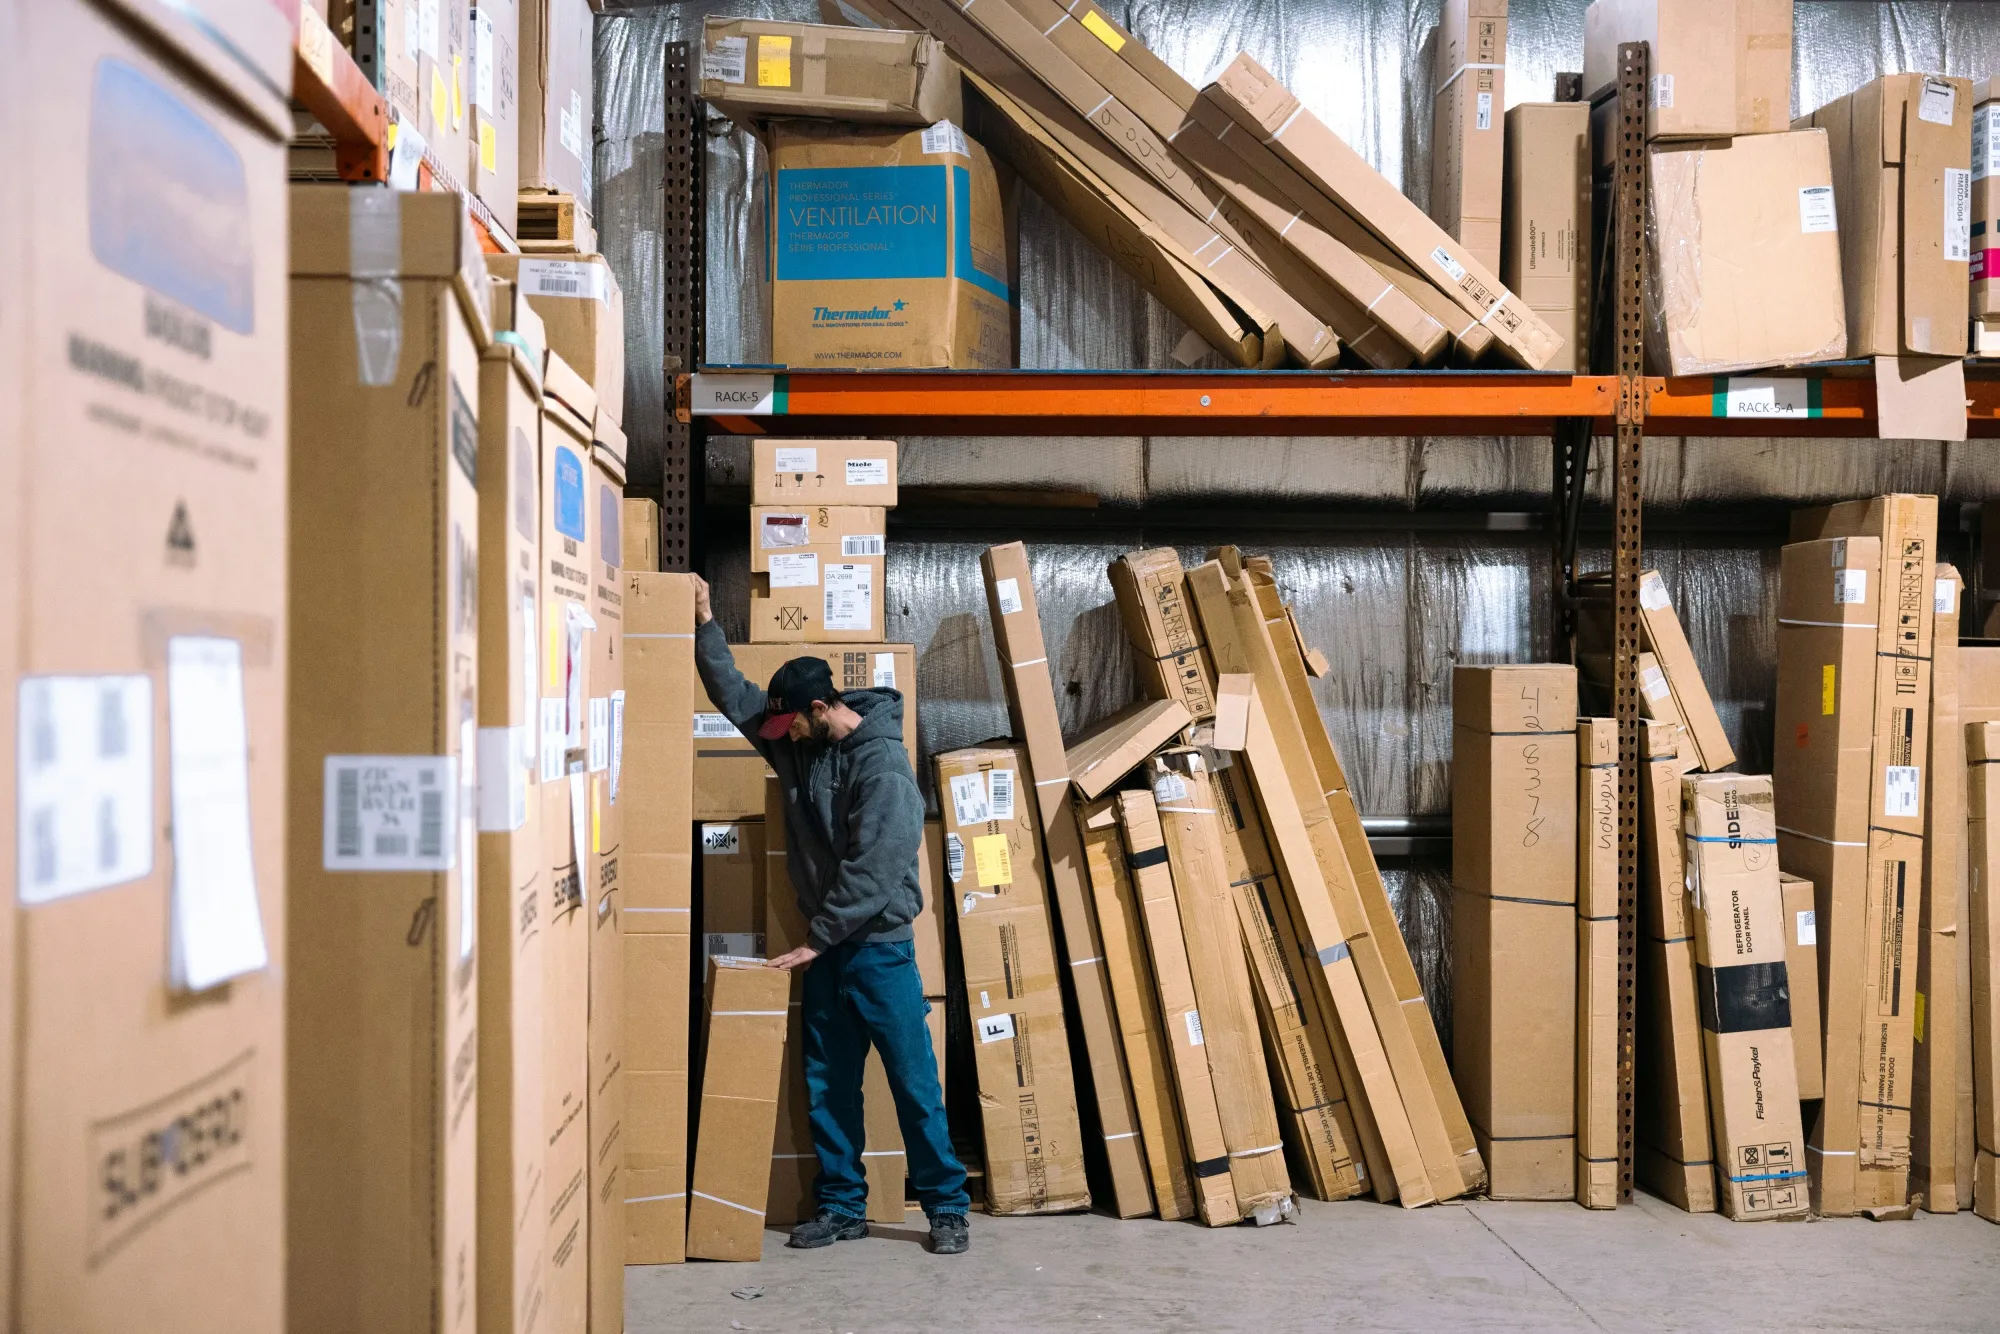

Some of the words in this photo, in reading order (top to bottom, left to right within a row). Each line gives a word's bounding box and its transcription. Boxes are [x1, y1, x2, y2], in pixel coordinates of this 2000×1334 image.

[789, 181, 849, 191] THERMADOR
[789, 193, 860, 203] PROFESSIONAL
[863, 191, 894, 201] SERIES
[789, 204, 937, 227] VENTILATION
[789, 231, 850, 241] THERMADOR
[817, 242, 889, 252] PROFESSIONAL
[1477, 287, 1486, 296] 10
[812, 305, 892, 321] Thermador
[814, 351, 902, 359] WWW.THERMADOR.COM
[715, 391, 759, 402] RACK-5
[1738, 401, 1794, 413] RACK-5-A
[1726, 810, 1742, 850] SIDE
[1731, 889, 1744, 955] REFRIGERATOR
[1743, 906, 1752, 931] PANEL
[1894, 912, 1903, 968] AVERTISSEMENT
[986, 1024, 1005, 1036] F
[1880, 1022, 1888, 1061] ENSEMBLE
[1295, 1034, 1311, 1071] ENSEMBLE
[1879, 1061, 1886, 1073] DE
[1306, 1069, 1315, 1082] DE
[1313, 1063, 1324, 1083] DOOR
[1320, 1083, 1331, 1106] PANE
[1877, 1074, 1885, 1112] PANNEAX
[1310, 1081, 1326, 1119] PANNEUX
[1321, 1118, 1330, 1130] DE
[1877, 1113, 1884, 1125] DE
[1325, 1130, 1337, 1153] PORTE
